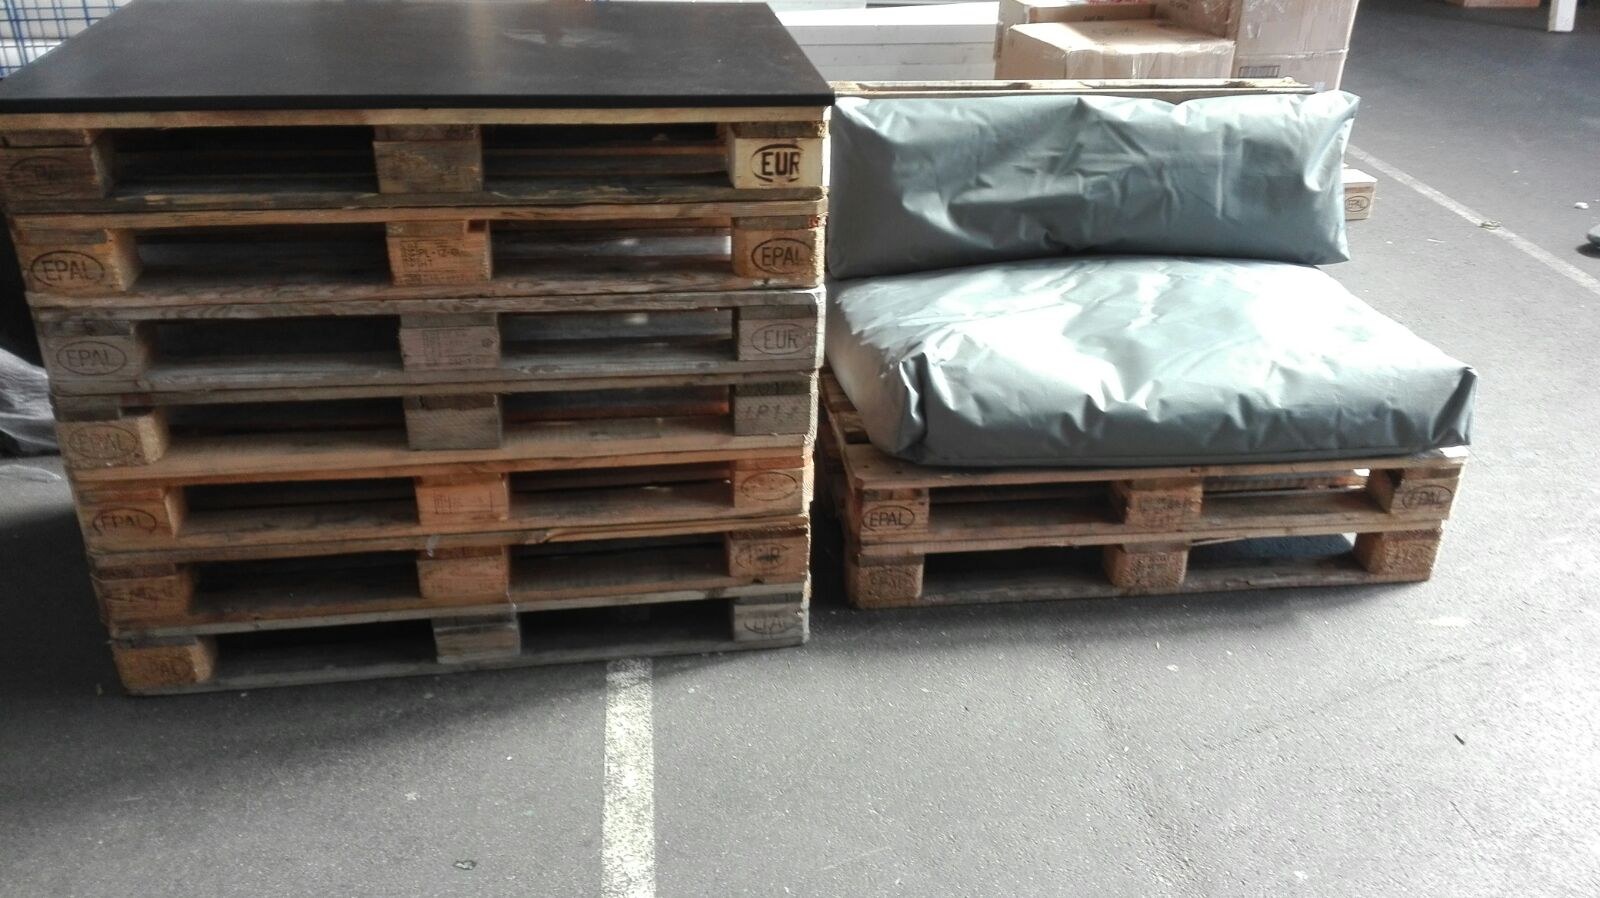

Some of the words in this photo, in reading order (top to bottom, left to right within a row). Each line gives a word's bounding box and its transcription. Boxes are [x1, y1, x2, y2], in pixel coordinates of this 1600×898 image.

[761, 151, 800, 176] EUR
[41, 257, 96, 282] EPAL
[763, 329, 799, 349] EUR
[65, 348, 111, 368] EPAL
[869, 511, 906, 527] EPAL
